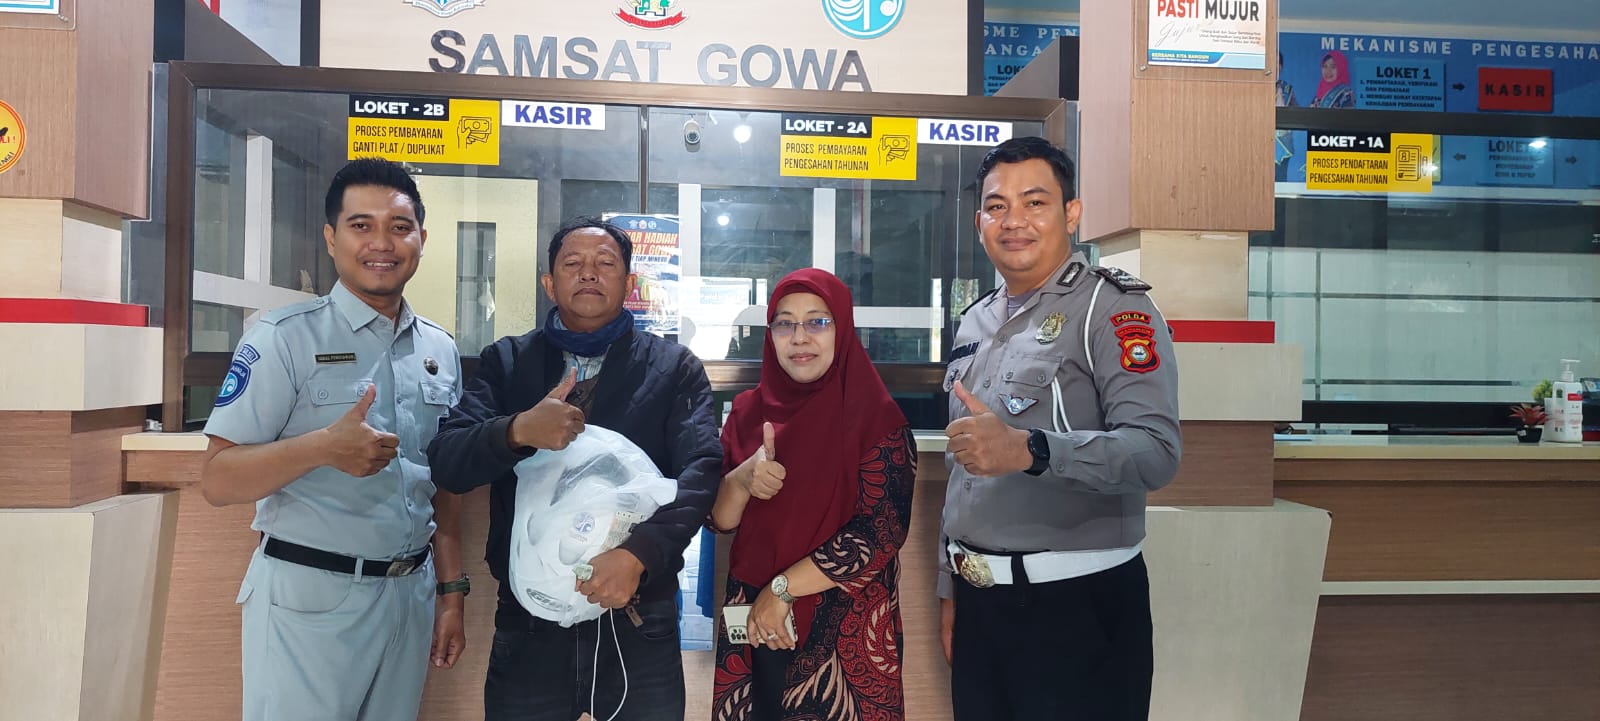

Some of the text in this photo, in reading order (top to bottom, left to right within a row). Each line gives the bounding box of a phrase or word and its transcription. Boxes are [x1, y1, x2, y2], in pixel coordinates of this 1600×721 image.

[1157, 0, 1260, 21] PASTI MUJUR
[1321, 37, 1600, 60] MEKANISME PENGESAHA
[428, 29, 873, 93] SAMSAT GOWA
[1376, 66, 1431, 79] LOKET 1
[1485, 84, 1545, 97] KASIR
[354, 100, 409, 114] LOKET
[423, 103, 445, 116] 2B
[515, 104, 592, 126] KASIR
[355, 125, 443, 139] PROSES PEMBAYARAN
[785, 119, 835, 132] LOKET
[847, 122, 867, 134] 2A
[929, 123, 1000, 142] KASIR
[353, 141, 378, 153] GANTI
[379, 142, 398, 154] PLAT
[407, 143, 446, 156] DUPLIKAT
[1311, 135, 1356, 147] LOKET
[1367, 137, 1384, 148] 1A
[785, 142, 867, 156] PROSES PEMBAYARAN
[784, 159, 869, 171] PENGESAHAN TAHUNAN
[1312, 157, 1388, 169] PROSES PENDAFTARAN
[1310, 172, 1388, 184] PENGESAHAN TAHUNAN
[644, 232, 678, 245] HADIAH
[1115, 313, 1145, 322] POLDA
